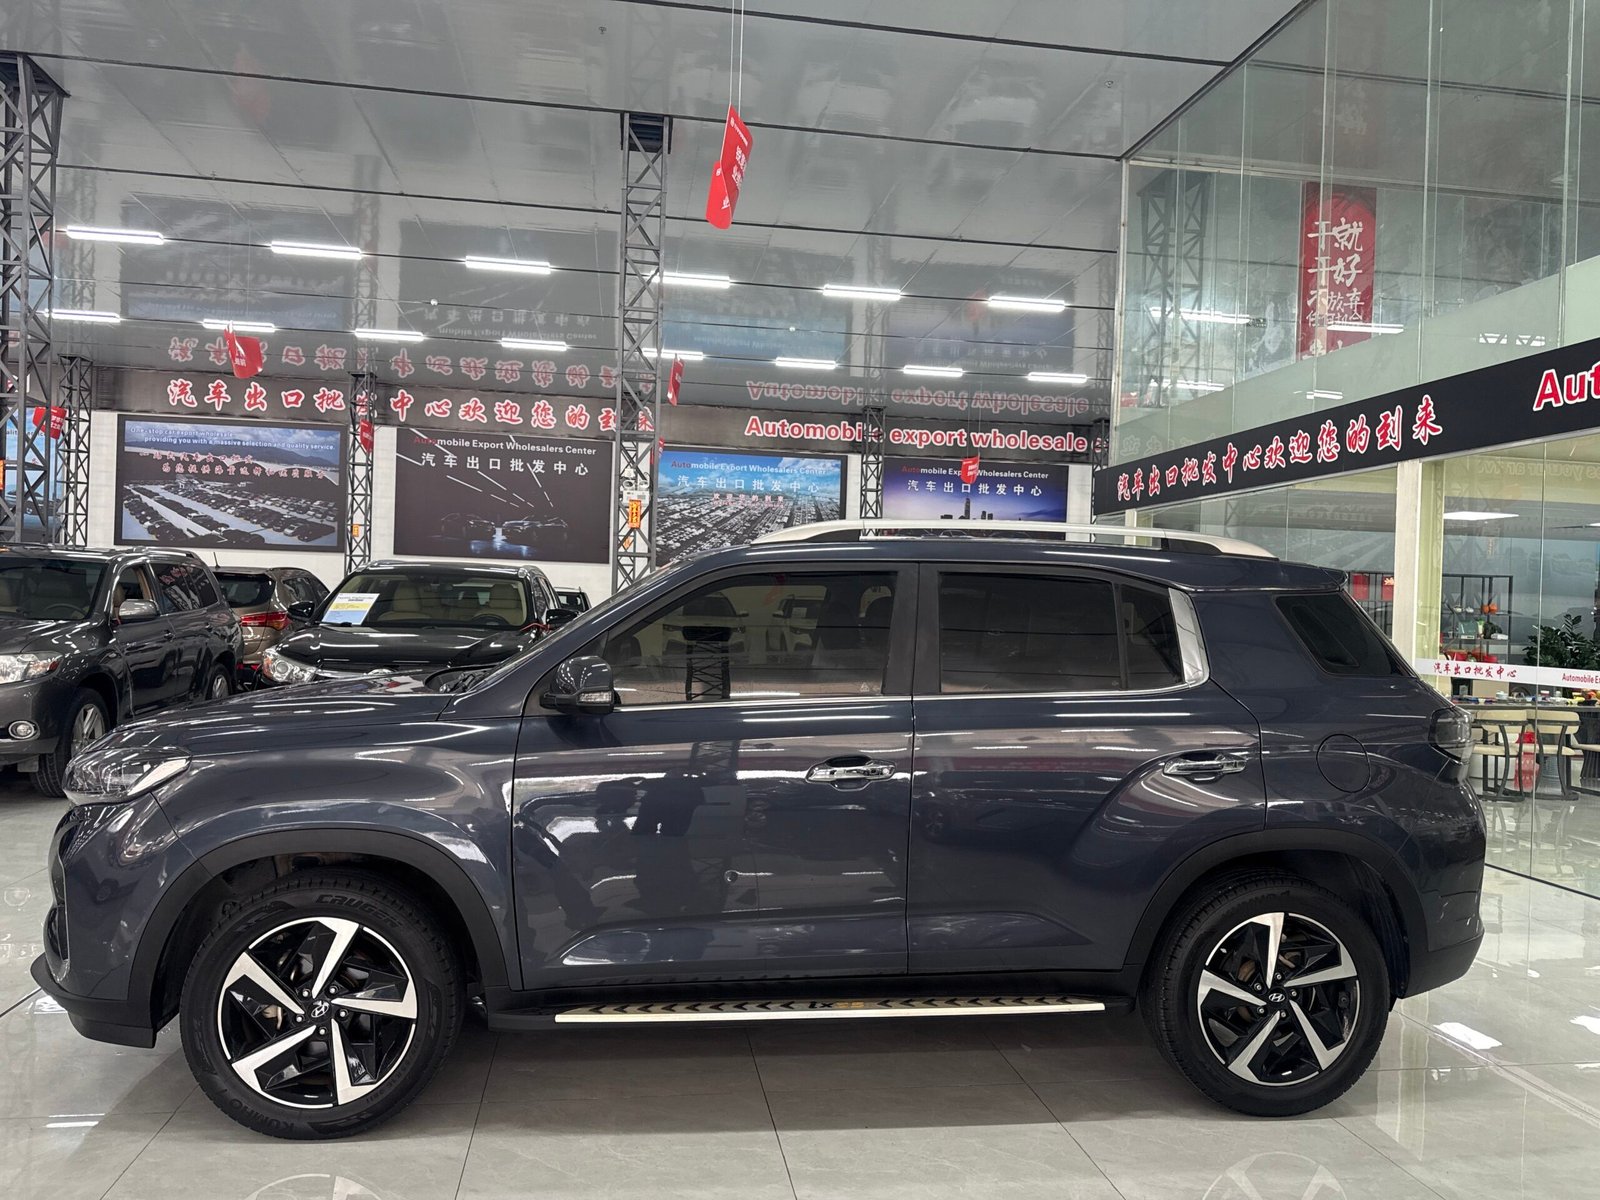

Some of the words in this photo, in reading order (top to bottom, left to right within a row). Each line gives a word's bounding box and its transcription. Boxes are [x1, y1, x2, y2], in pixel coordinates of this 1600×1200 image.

[1533, 361, 1600, 411] Aut
[144, 436, 177, 444] providing
[287, 442, 309, 450] quality
[414, 436, 470, 448] Automobile
[472, 440, 504, 451] Export
[506, 441, 563, 454] Wholesalers
[565, 445, 597, 455] Center
[889, 427, 967, 448] export
[972, 429, 1087, 453] wholesale
[1117, 394, 1443, 502] 汽车出口批发中心欢迎您的到来
[421, 452, 589, 476] 汽车出口批发中心
[671, 460, 719, 470] Automobile
[720, 463, 748, 473] Export
[749, 464, 798, 474] Wholesalers
[800, 467, 827, 475] Center
[902, 465, 947, 475] Automobile
[1023, 470, 1049, 479] Center
[677, 475, 819, 493] 汽车出口批发中心
[908, 479, 1042, 496] 汽车出口批发中心
[1433, 662, 1517, 679] 汽车出口批发中心
[1562, 673, 1594, 684] Automobile
